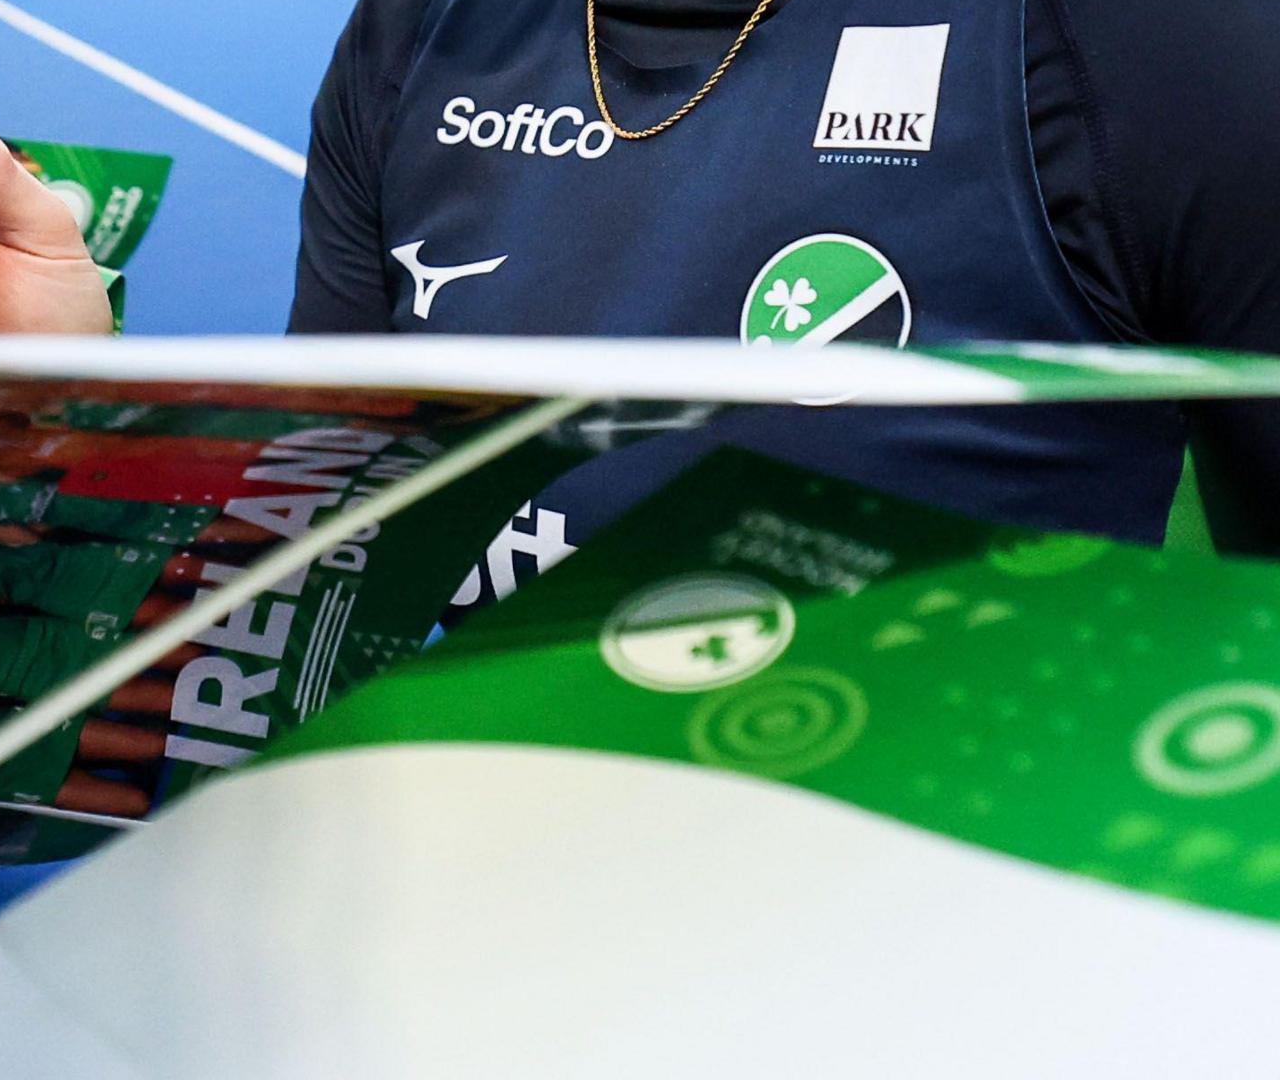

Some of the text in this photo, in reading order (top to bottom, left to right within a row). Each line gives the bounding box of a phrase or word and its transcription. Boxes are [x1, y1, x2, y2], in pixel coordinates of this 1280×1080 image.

[436, 96, 616, 160] SoftCo
[823, 111, 927, 143] PARK
[818, 154, 919, 168] DEVELOPMENTS
[164, 427, 398, 768] IRELAND
